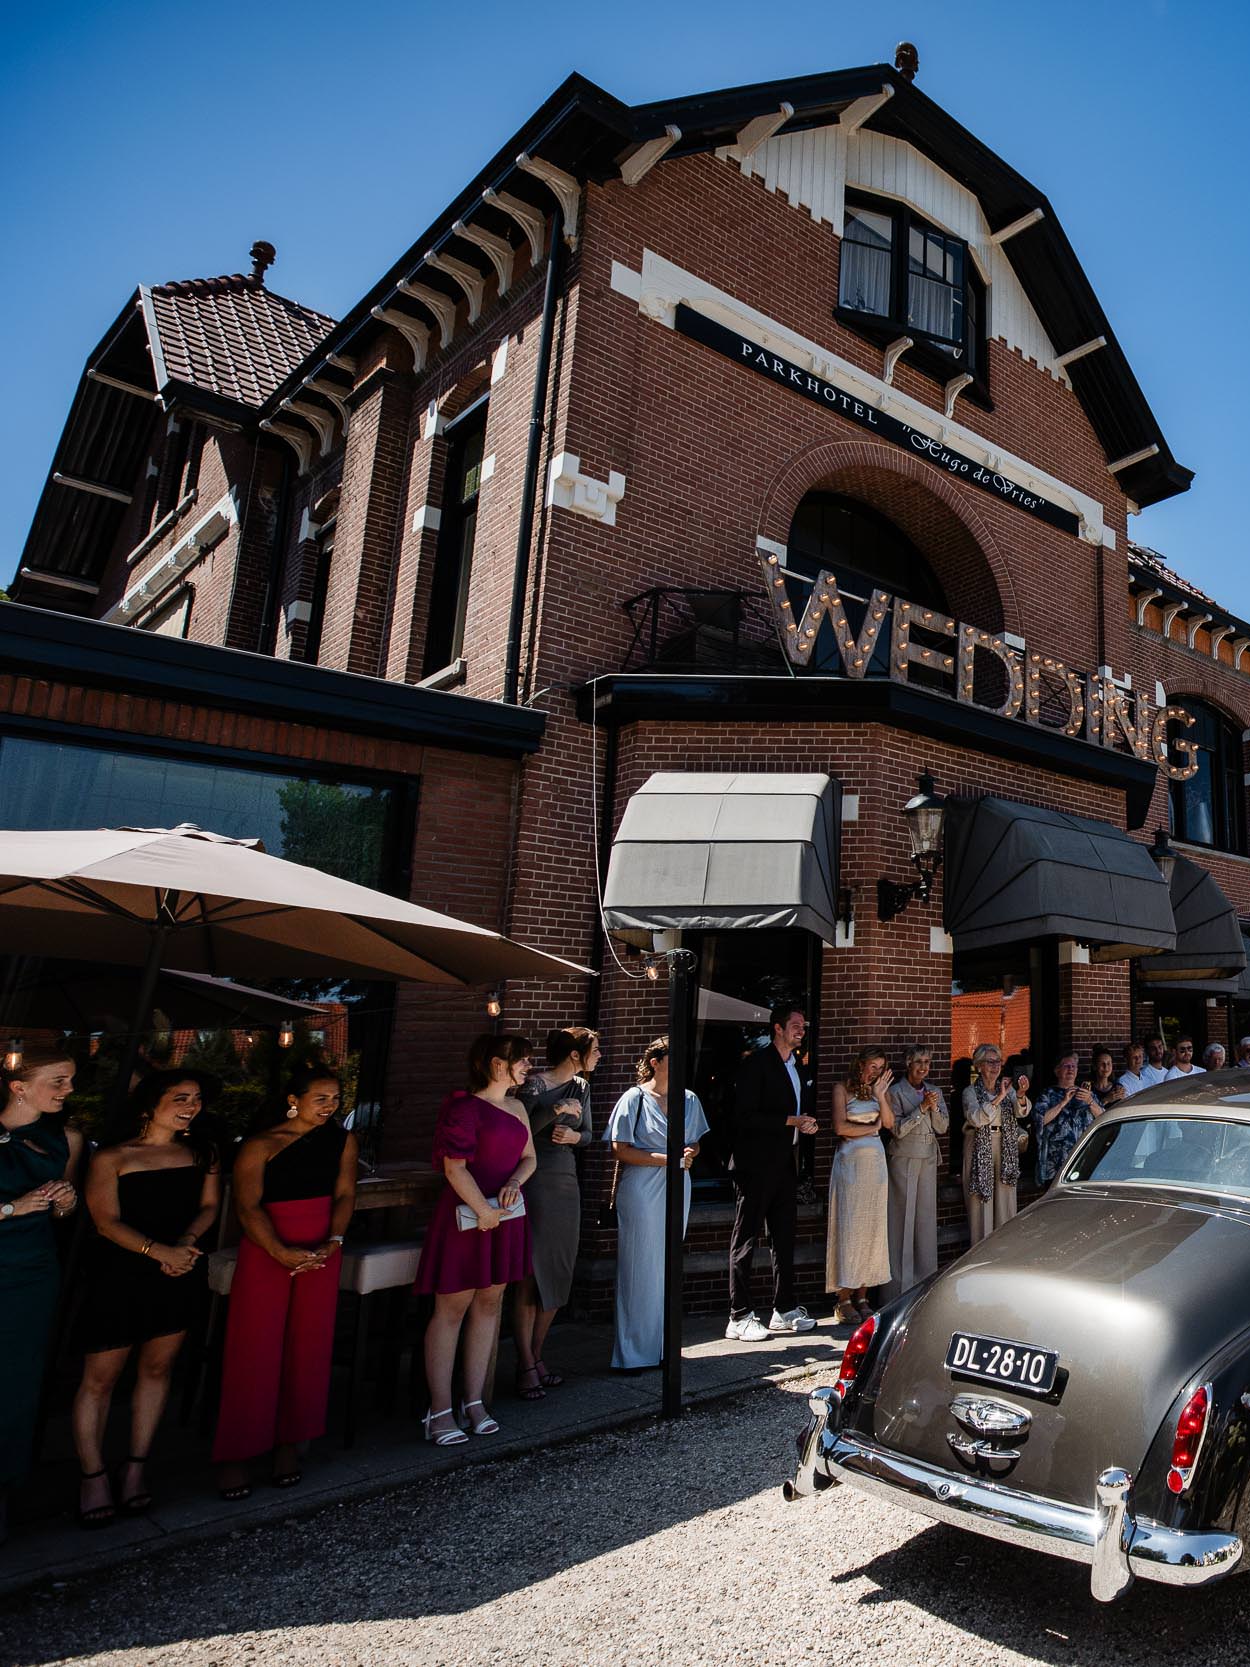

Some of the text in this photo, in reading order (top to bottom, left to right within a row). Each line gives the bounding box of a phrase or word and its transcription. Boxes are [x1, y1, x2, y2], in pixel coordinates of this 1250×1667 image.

[741, 342, 878, 425] PARKHOTEL
[973, 467, 990, 484] de
[756, 547, 1200, 780] WEDDING
